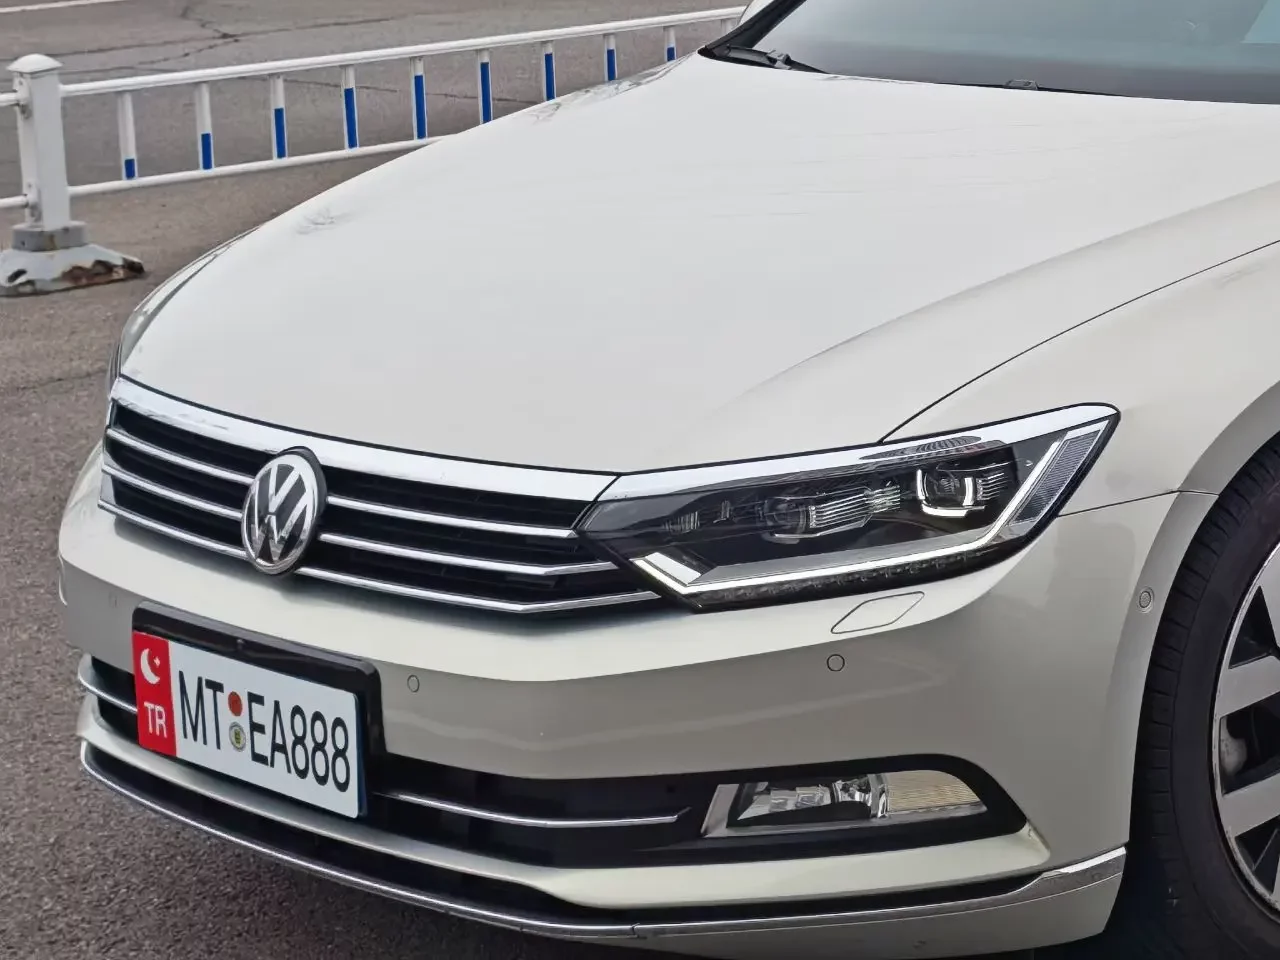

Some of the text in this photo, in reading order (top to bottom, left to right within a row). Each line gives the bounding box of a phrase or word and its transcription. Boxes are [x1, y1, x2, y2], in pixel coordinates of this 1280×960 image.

[245, 456, 317, 565] VW
[144, 701, 167, 738] TR
[179, 670, 350, 792] MT EA888
